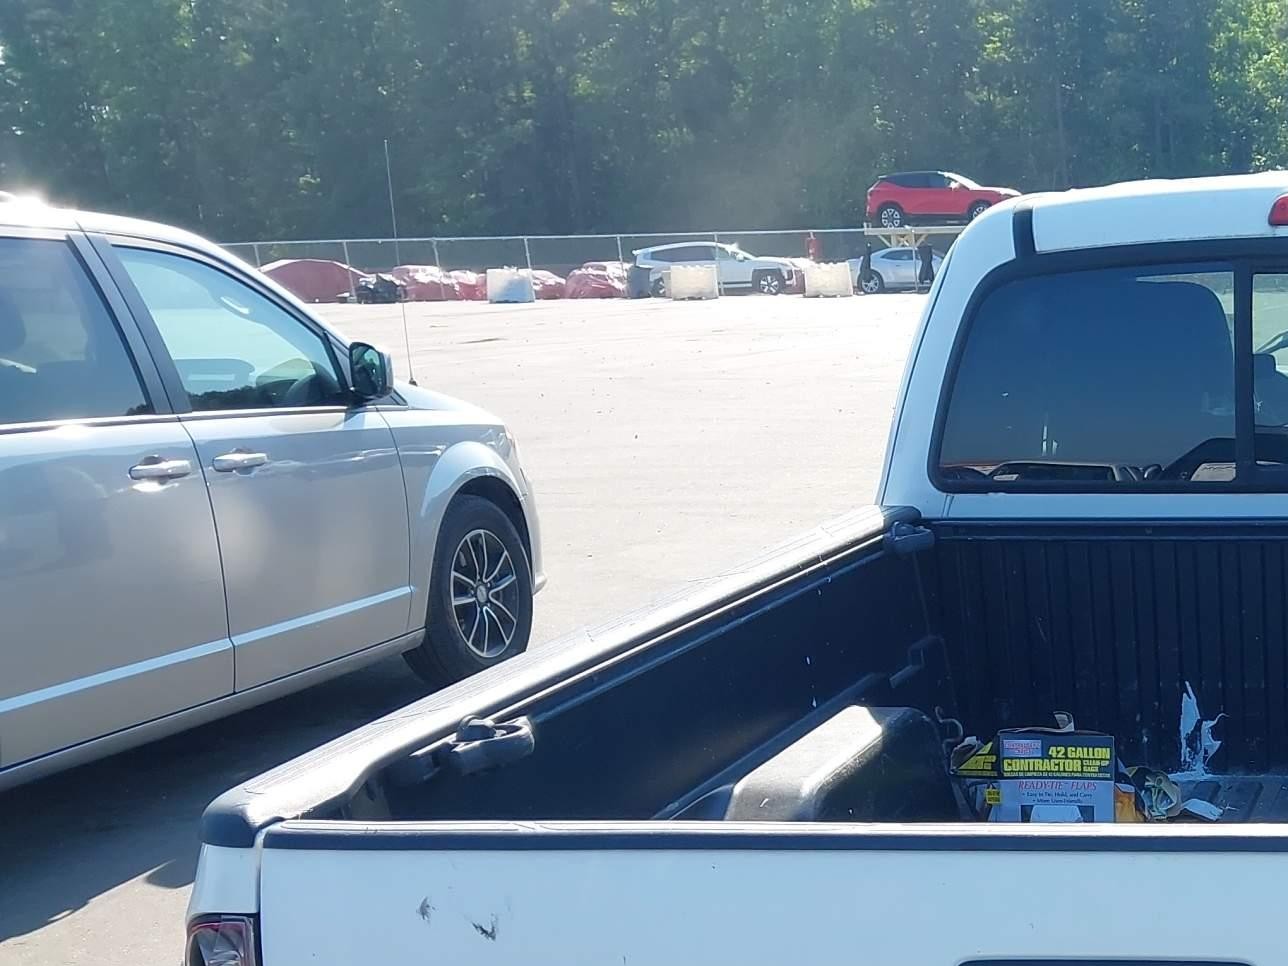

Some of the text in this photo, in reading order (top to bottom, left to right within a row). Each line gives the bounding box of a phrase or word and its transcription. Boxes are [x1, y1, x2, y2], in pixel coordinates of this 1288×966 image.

[1048, 746, 1066, 759] 42
[1067, 747, 1111, 759] GALLON
[1003, 759, 1081, 772] CONTRACTOR
[1071, 781, 1097, 790] FLAPS
